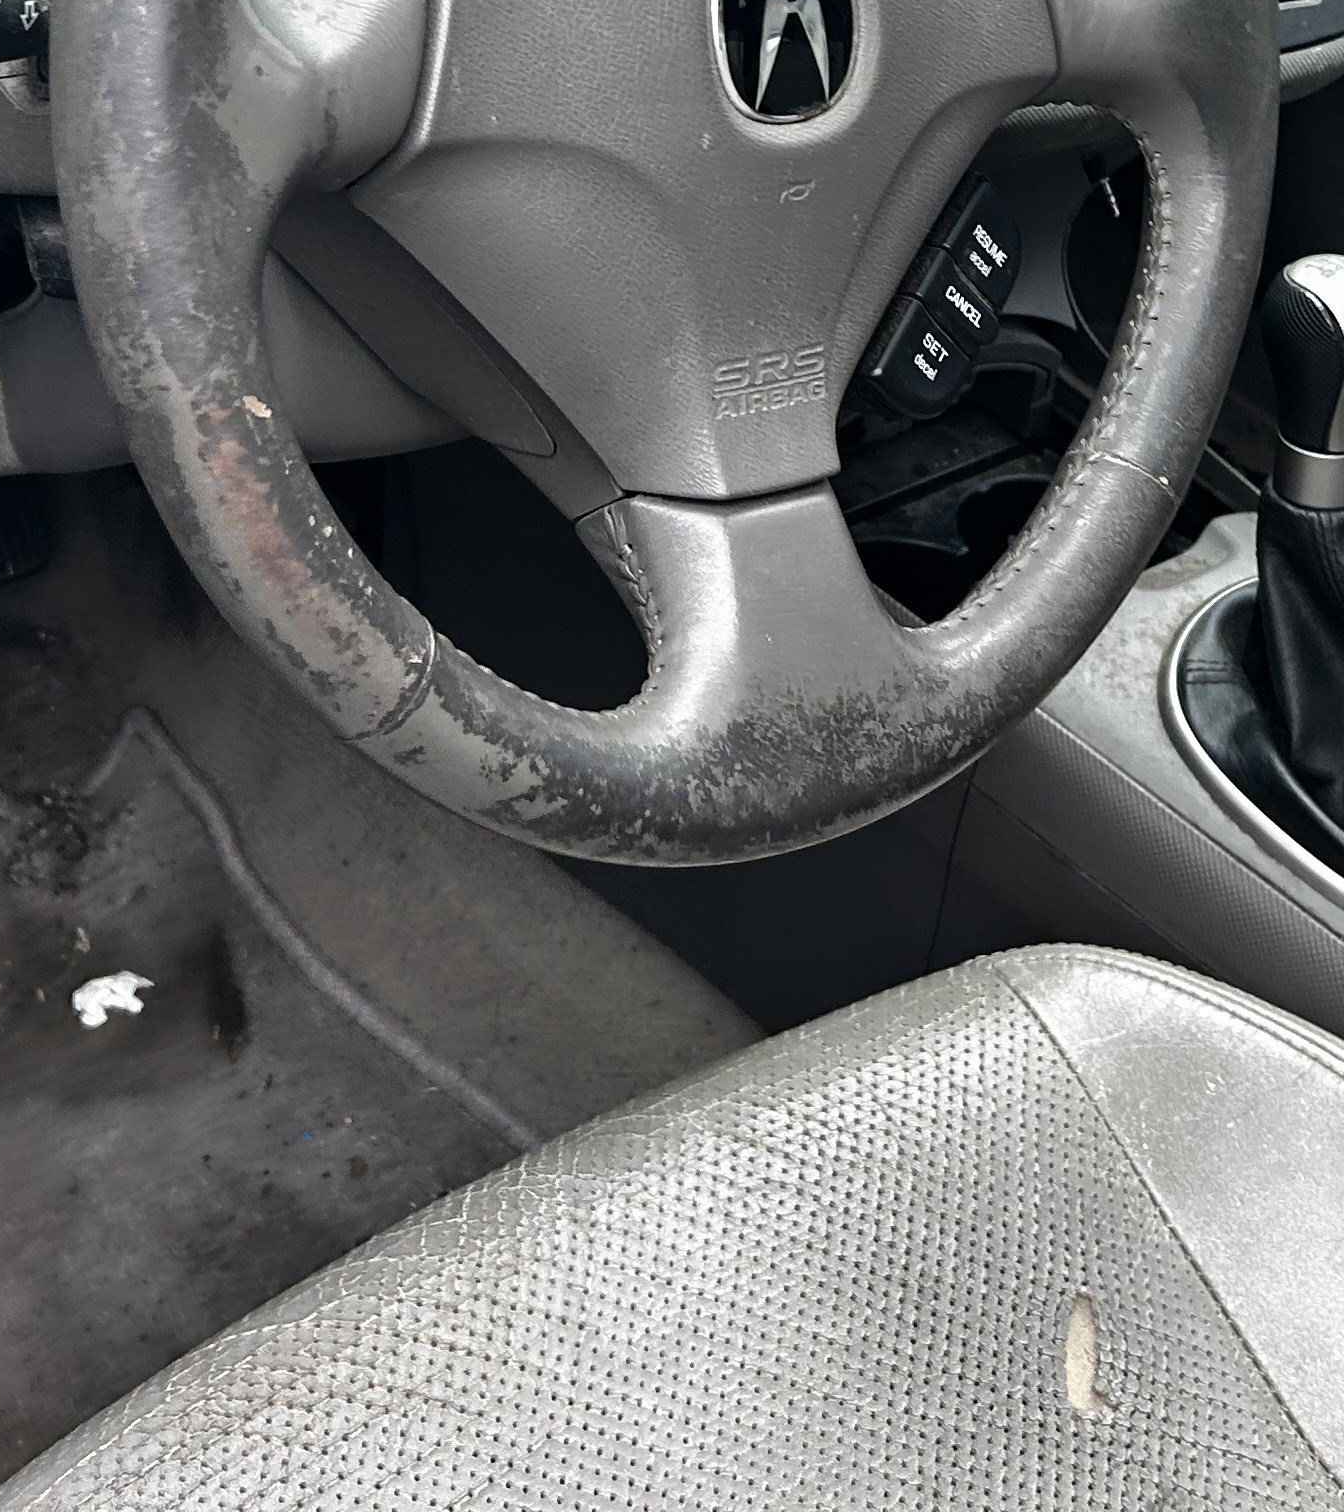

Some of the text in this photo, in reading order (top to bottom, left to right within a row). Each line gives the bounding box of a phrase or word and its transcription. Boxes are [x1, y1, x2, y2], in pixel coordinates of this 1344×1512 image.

[969, 251, 993, 278] accel
[972, 224, 1008, 268] RESUME
[945, 286, 982, 328] CANCEL
[913, 353, 938, 381] decel
[922, 332, 949, 363] SET
[713, 344, 825, 392] SRS
[714, 380, 826, 420] AIRBAG
